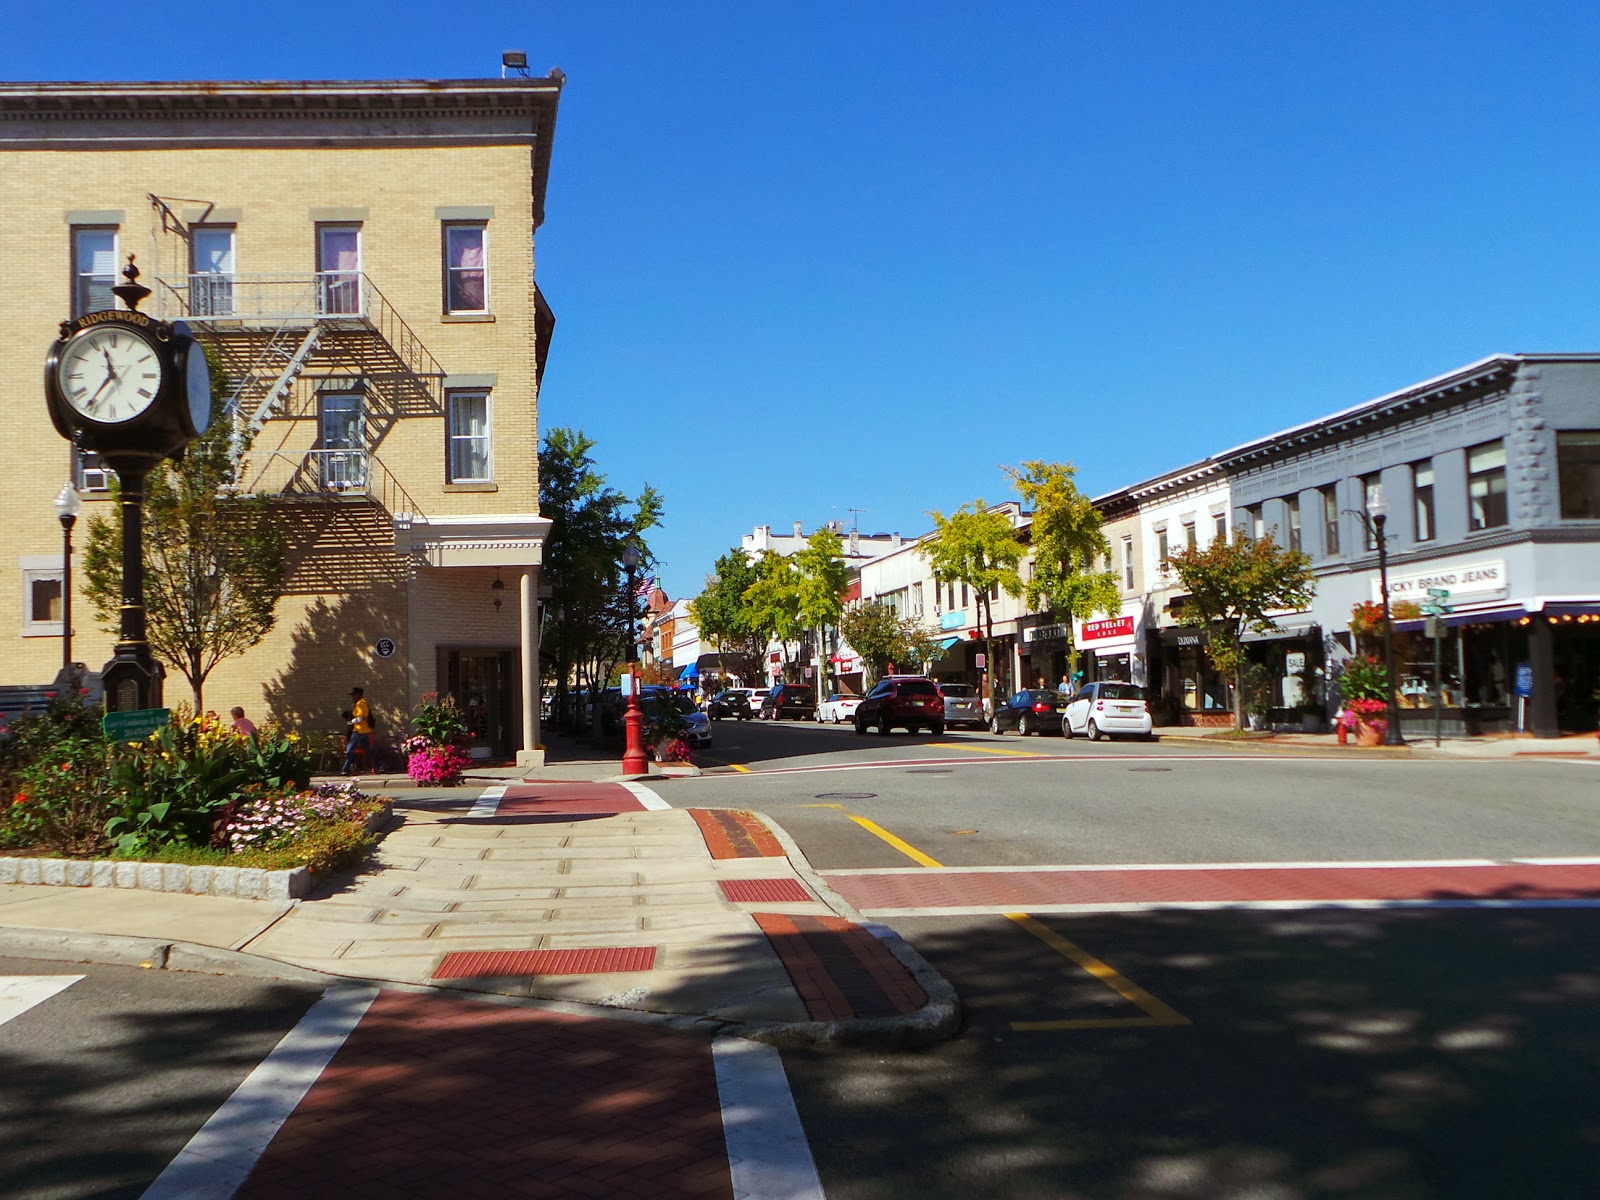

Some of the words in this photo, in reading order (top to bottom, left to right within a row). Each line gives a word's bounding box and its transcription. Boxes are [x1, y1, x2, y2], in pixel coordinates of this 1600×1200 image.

[78, 311, 149, 327] RIDGEWOOD
[1418, 574, 1457, 589] BRAND
[1462, 568, 1498, 583] JEANS
[1288, 658, 1305, 668] SALE
